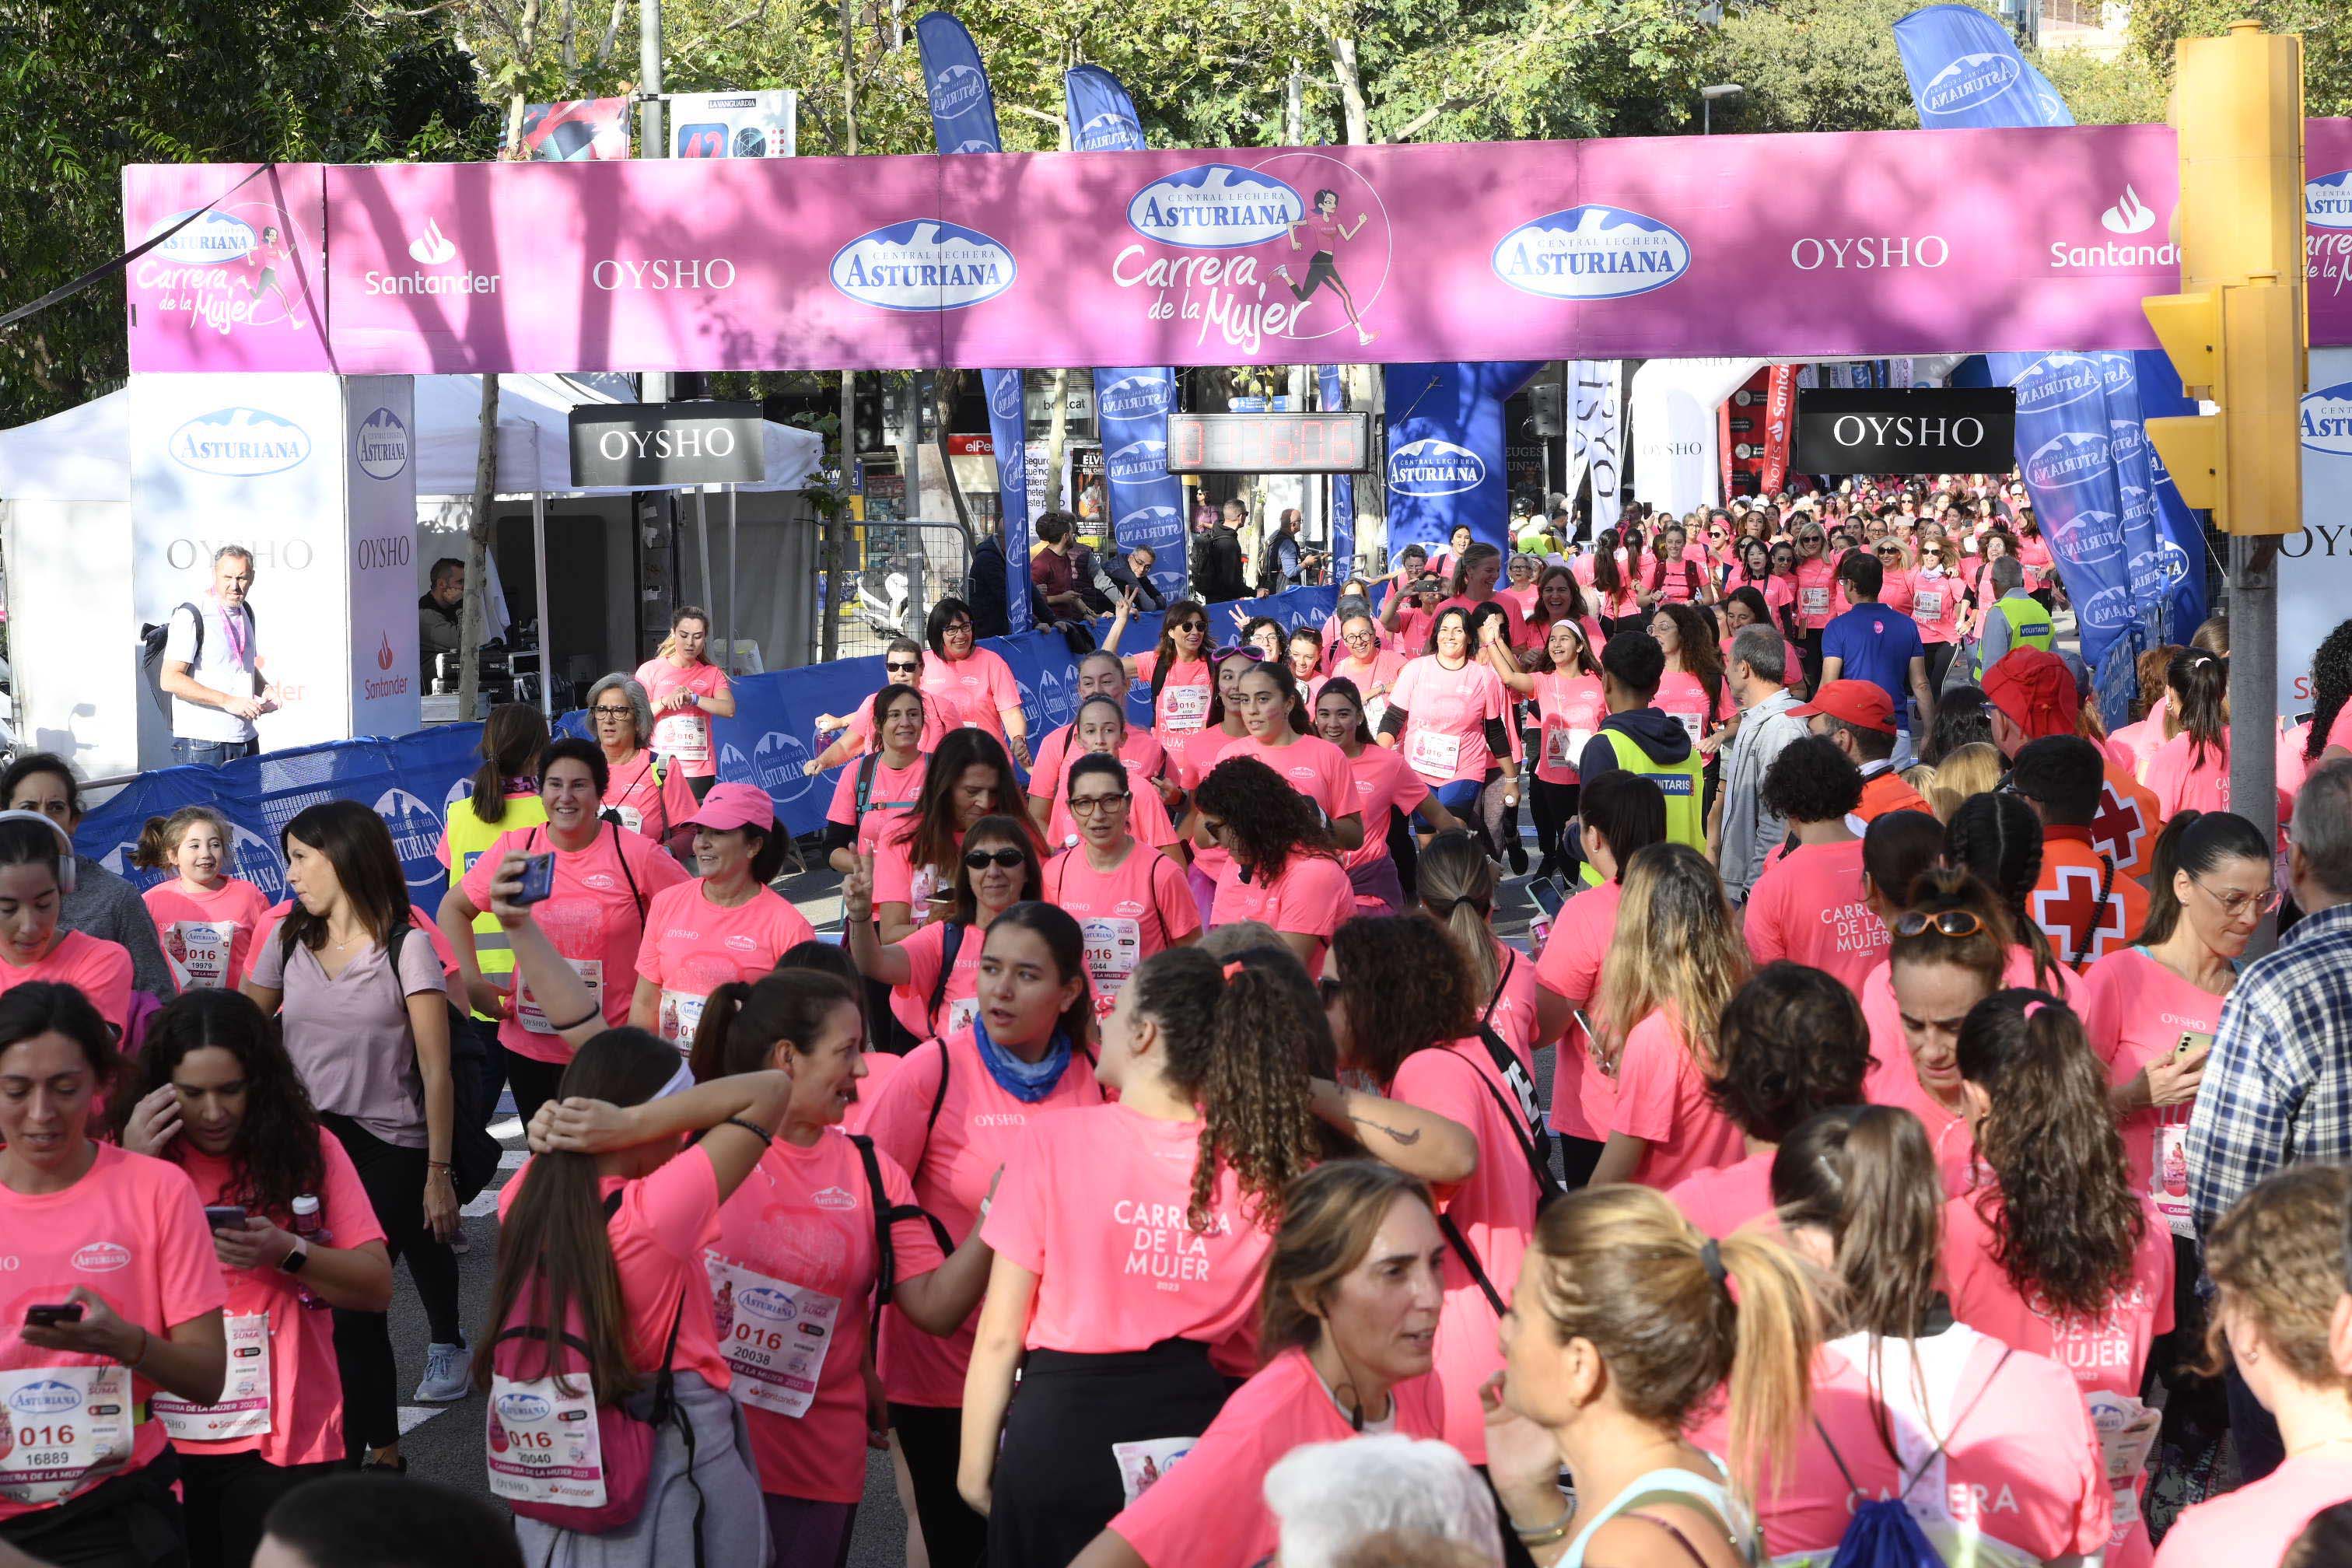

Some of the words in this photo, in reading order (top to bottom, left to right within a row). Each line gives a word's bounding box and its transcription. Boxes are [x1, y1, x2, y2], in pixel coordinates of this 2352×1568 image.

[1167, 193, 1224, 202] CENTRAL
[1229, 191, 1285, 201] LECHERA
[1141, 195, 1290, 227] ASTURIANA
[1538, 237, 1600, 248] CENTRAL
[1605, 236, 1668, 247] LECHERA
[1791, 235, 1949, 270] OYSHO
[873, 250, 933, 261] CENTRAL
[937, 249, 996, 260] LECHERA
[1112, 243, 1258, 288] Carrera
[1507, 242, 1675, 275] ASTURIANA
[136, 260, 229, 289] Carrera
[365, 269, 500, 296] Santander
[593, 258, 736, 292] OYSHO
[845, 254, 1003, 289] ASTURIANA
[159, 291, 177, 310] de
[180, 290, 192, 311] la
[191, 288, 262, 335] Mujer
[1148, 289, 1175, 320] de
[1181, 289, 1200, 320] la
[1197, 280, 1312, 355] Mujer
[1832, 415, 1985, 448] OYSHO
[181, 432, 300, 459] ASTURIANA
[360, 438, 405, 463] ASTURIANA
[600, 427, 736, 461] OYSHO
[1391, 462, 1478, 484] ASTURIANA
[359, 535, 410, 571] OYSHO
[365, 676, 408, 701] Santander
[188, 933, 219, 941] ASTURIANA
[667, 929, 699, 940] OYSHO
[1837, 919, 1860, 936] DE
[1865, 915, 1886, 932] LA
[1836, 930, 1892, 953] MUJER
[189, 949, 216, 960] 016
[1085, 948, 1113, 961] 016
[523, 1017, 548, 1028] OYSHO
[2161, 1013, 2207, 1031] OYSHO
[975, 1113, 1025, 1128] OYSHO
[1134, 1227, 1167, 1254] DE
[1177, 1231, 1207, 1258] LA
[1124, 1251, 1210, 1283] MUJER
[741, 1293, 792, 1318] ASTURIANA
[735, 1323, 782, 1351] 016
[733, 1346, 772, 1367] 20038
[758, 1369, 785, 1383] MUJER
[15, 1395, 76, 1407] ASTURIANA
[87, 1386, 119, 1395] SUMA
[760, 1389, 803, 1407] Santander
[186, 1404, 197, 1412] DE
[239, 1400, 257, 1409] 2023
[219, 1417, 261, 1429] Santander
[19, 1424, 75, 1447] 016
[509, 1430, 553, 1448] 016
[26, 1451, 69, 1466] 16889
